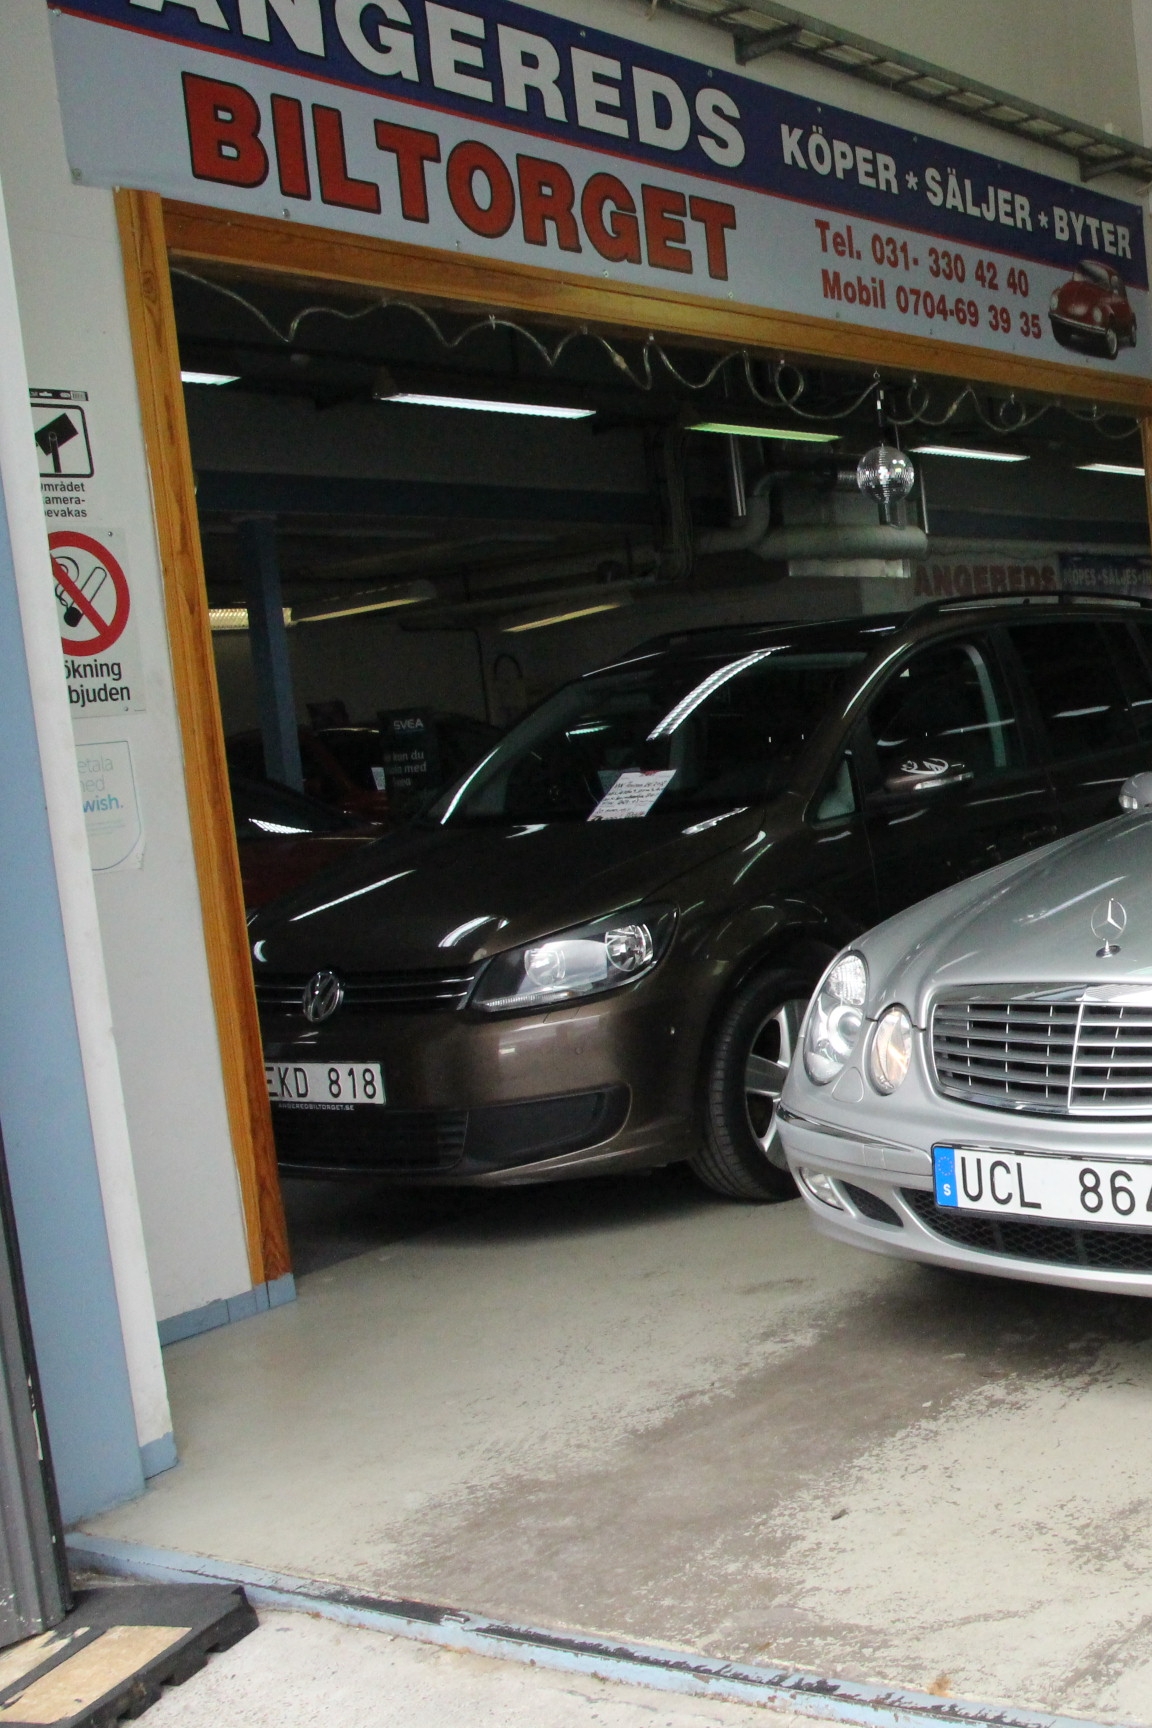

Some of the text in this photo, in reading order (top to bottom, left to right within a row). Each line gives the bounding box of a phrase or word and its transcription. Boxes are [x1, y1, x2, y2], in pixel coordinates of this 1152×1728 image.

[129, 0, 746, 168] NGEREDS
[181, 72, 736, 281] BILTORGET
[780, 123, 1132, 259] KÖPER SÄLJER BYTER
[815, 219, 1029, 297] Tel. 031- 330 42 40
[821, 269, 1042, 339] Mobil 0704-69 39 35
[43, 496, 85, 504] amera-
[64, 659, 122, 681] ökning
[68, 683, 130, 707] bjuden
[393, 718, 424, 731] SVEA
[77, 754, 113, 774] etala
[411, 749, 424, 760] du
[404, 761, 427, 773] med
[83, 794, 123, 813] wish.
[328, 1067, 377, 1099] 818
[943, 1184, 951, 1196] S
[961, 1156, 1042, 1210] UCL
